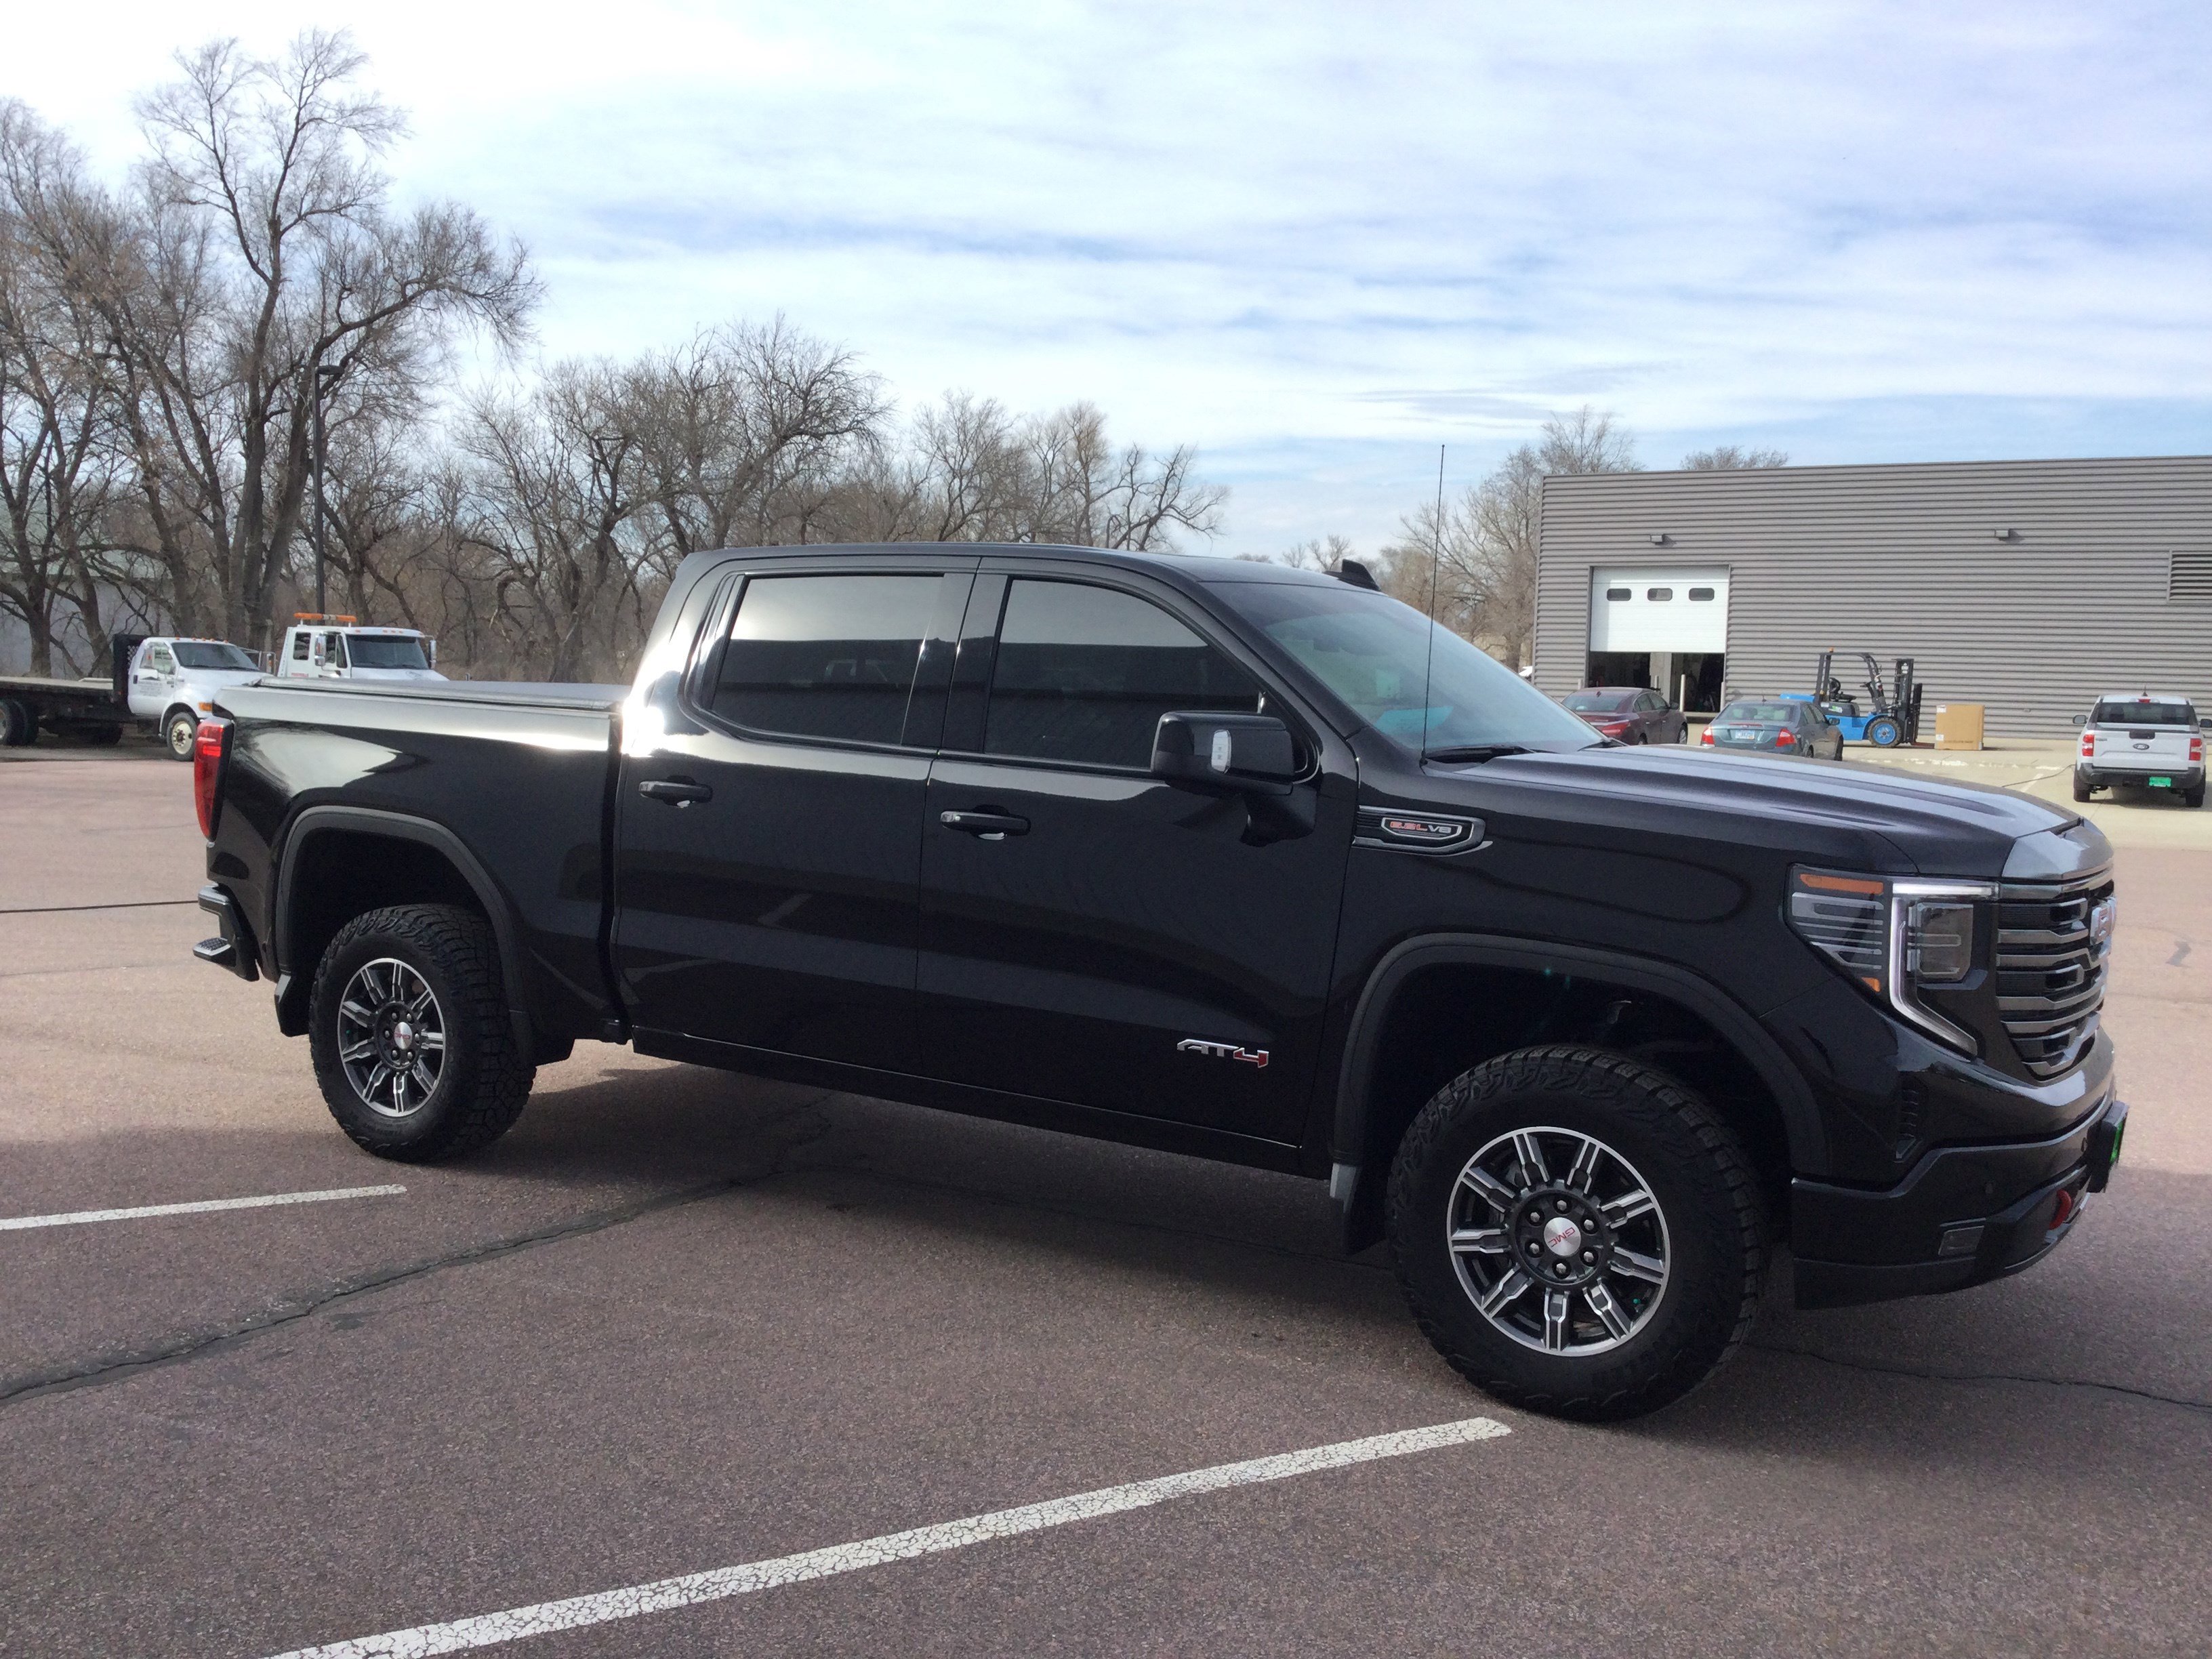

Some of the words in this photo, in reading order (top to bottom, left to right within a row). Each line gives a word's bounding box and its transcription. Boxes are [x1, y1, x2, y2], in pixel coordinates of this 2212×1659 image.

[1428, 825, 1452, 834] V8
[1176, 1039, 1269, 1068] AT4
[1548, 1227, 1576, 1248] GMC
